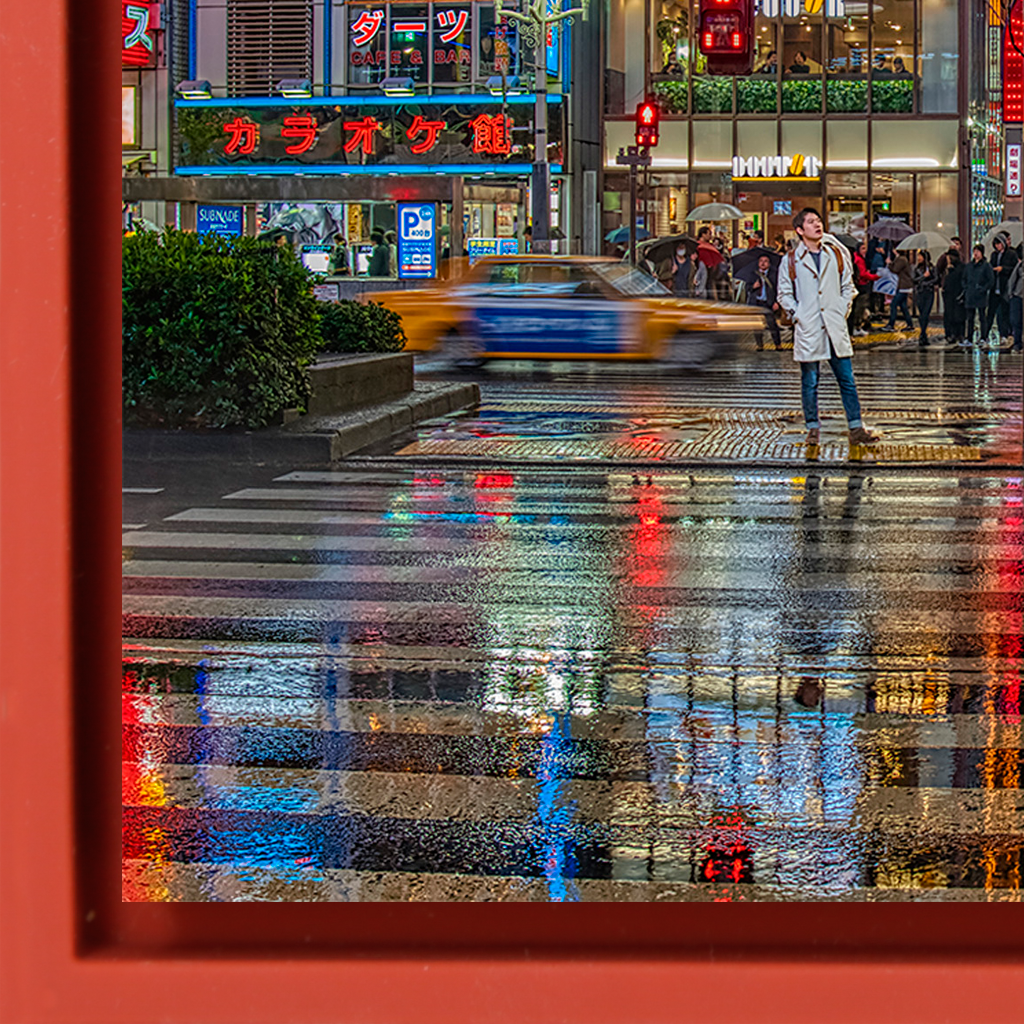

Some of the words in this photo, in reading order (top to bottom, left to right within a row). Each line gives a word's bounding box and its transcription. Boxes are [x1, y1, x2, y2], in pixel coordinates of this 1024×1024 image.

[351, 9, 469, 46] ダーツ
[351, 51, 401, 65] CAFE
[410, 50, 423, 64] &
[434, 49, 471, 64] BAR
[223, 113, 513, 155] カラオケ館
[403, 211, 420, 237] P
